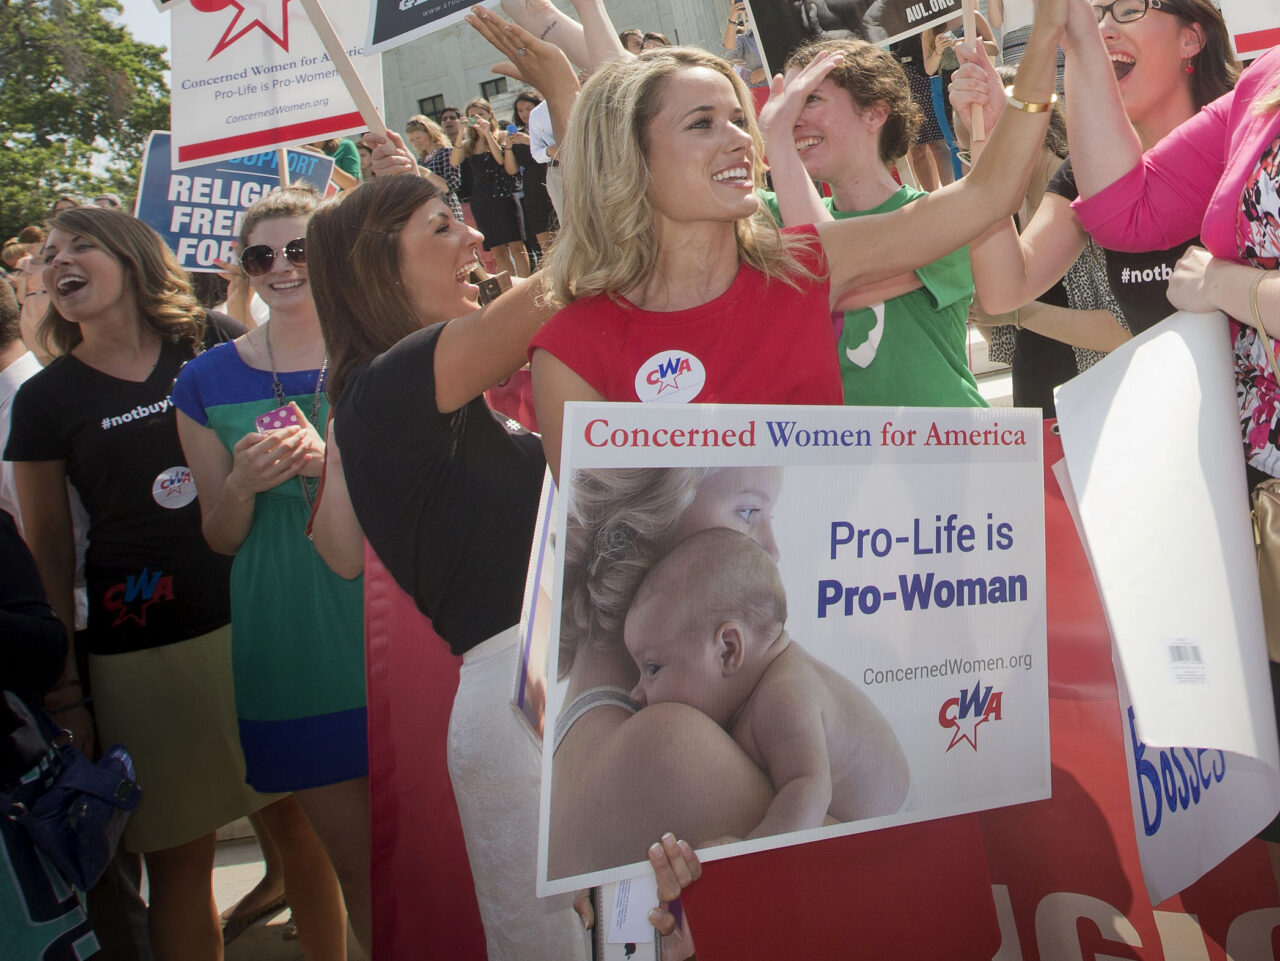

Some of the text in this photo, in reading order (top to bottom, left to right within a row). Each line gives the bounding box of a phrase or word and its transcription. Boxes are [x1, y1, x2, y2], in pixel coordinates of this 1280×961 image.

[181, 68, 248, 90] Concerned
[251, 60, 297, 77] Women
[301, 56, 318, 67] for
[214, 68, 340, 101] Pro-Life is Pro-Women
[225, 97, 329, 125] ConcernedWomen.org
[646, 357, 692, 386] CWA
[583, 418, 1027, 449] Concerned Women for America
[160, 470, 192, 491] CWA
[829, 512, 1014, 560] Pro-Life is
[103, 566, 174, 611] CWA
[817, 572, 1028, 619] Pro-Woman
[862, 652, 1033, 686] ConcernedWomen.org
[937, 680, 1004, 730] CWA
